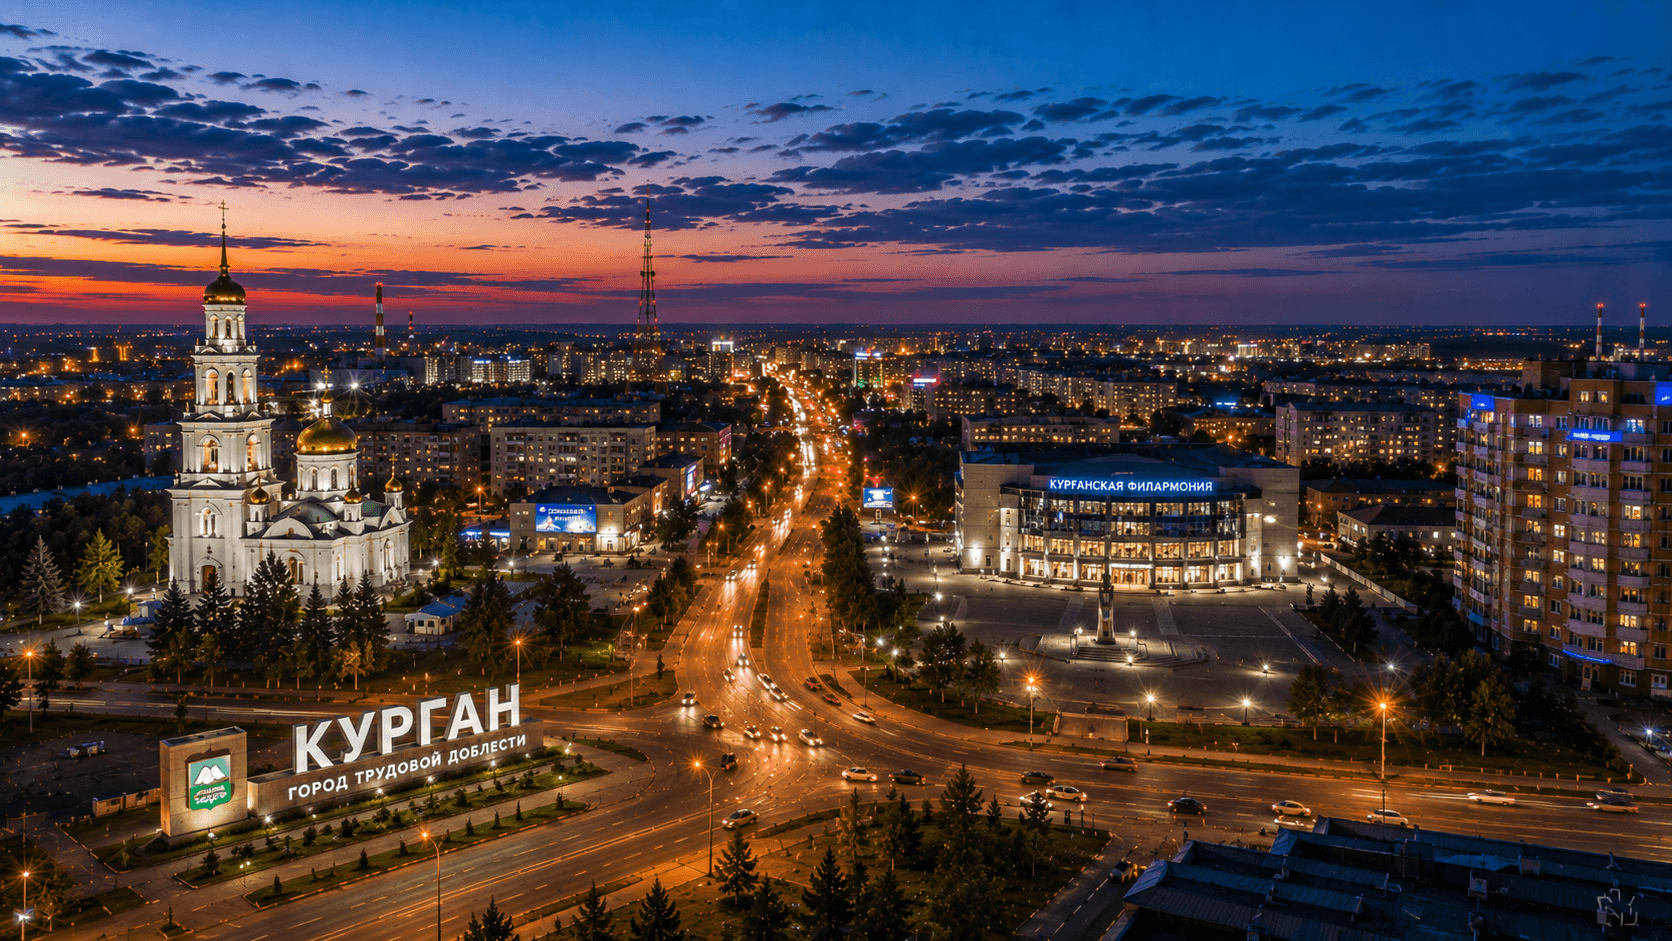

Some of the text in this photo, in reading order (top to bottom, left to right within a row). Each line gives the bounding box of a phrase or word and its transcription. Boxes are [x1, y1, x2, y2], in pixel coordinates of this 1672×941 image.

[1127, 481, 1213, 492] ФИЛАРМОНИЯ
[292, 682, 521, 774] КУРГАН
[288, 734, 527, 801] ГОРОД ТРУДОВОЙ ДОБЛЕСТИ
